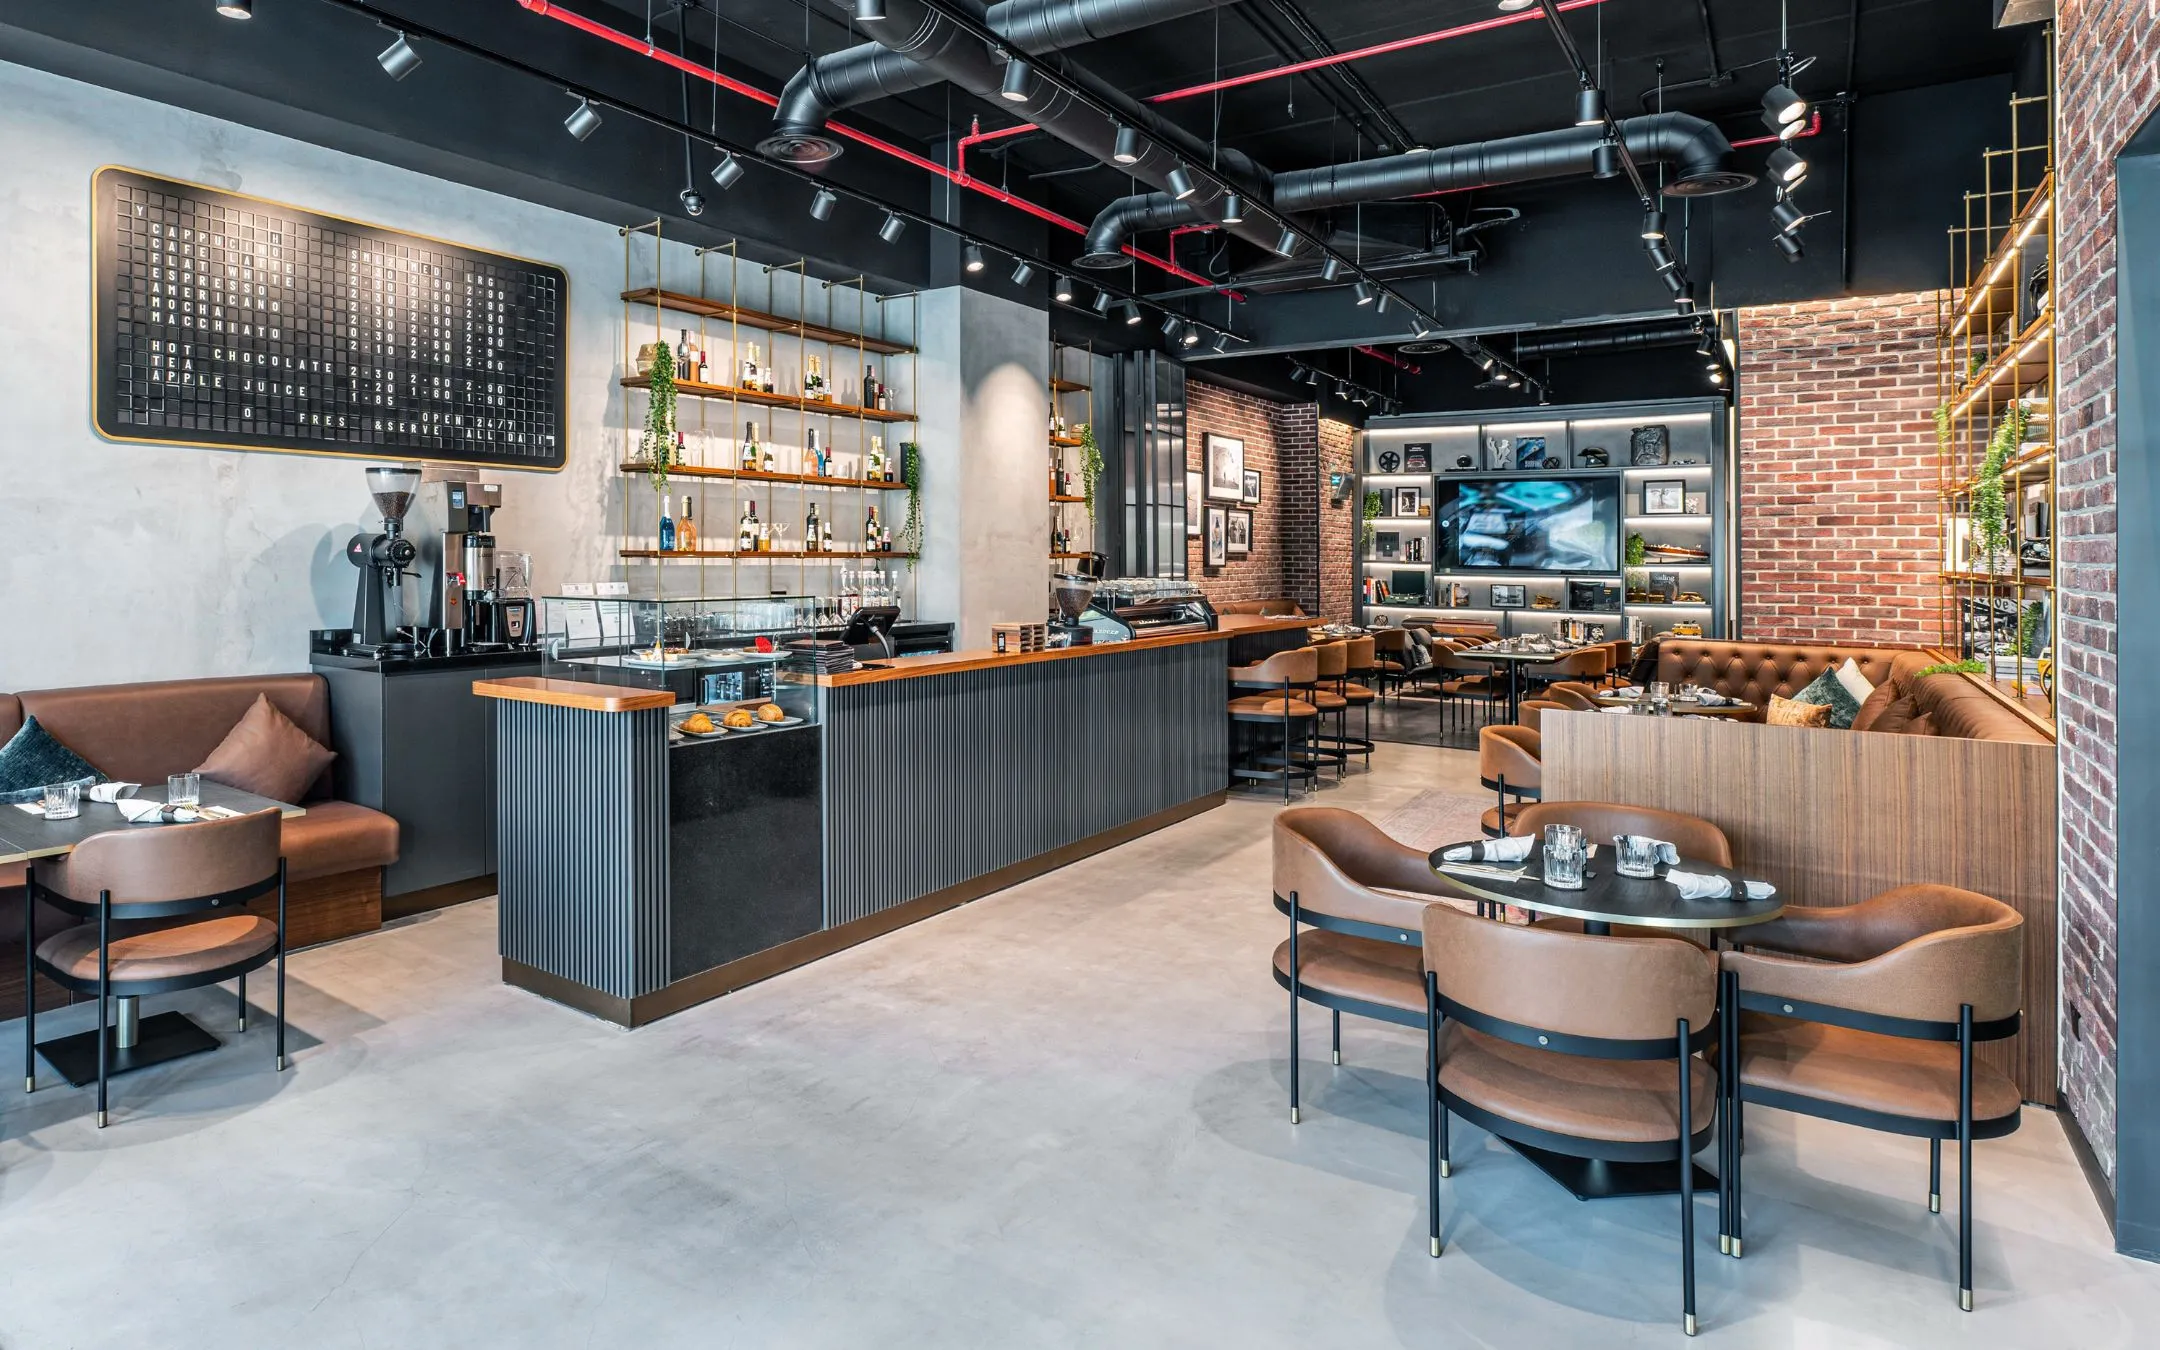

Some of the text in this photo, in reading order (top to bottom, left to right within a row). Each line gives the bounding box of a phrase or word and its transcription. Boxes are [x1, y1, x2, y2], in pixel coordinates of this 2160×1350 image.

[136, 205, 144, 217] Y
[272, 233, 279, 244] H
[411, 261, 439, 276] MED
[467, 273, 494, 287] LRG
[152, 223, 504, 300] CAPPUCINO 2.30 2.60 2.90
[152, 238, 504, 312] CAFE LATTE 2.30 2.60 2.90
[152, 253, 504, 323] FLAT WHITE 2.30 2.60 2.90
[152, 267, 504, 335] ESPRESSO 2.30 2.60 2.90
[152, 282, 504, 347] AMERICANO 2.30 2.60 2.90
[152, 296, 221, 317] MOCHA
[351, 328, 393, 342] 0.30
[411, 337, 450, 351] 2.60
[152, 311, 279, 339] MACCHIATO
[351, 340, 394, 355] 2.10
[411, 350, 450, 363] 2.40
[152, 340, 503, 394] HOT CHOCOLATE 2.30 2.60 2.90
[152, 355, 503, 406] TEA 1.20 1.60 1.90
[152, 370, 393, 406] APPLE JUICE 1.85
[300, 413, 345, 427] FRES
[466, 429, 493, 440] ALL
[508, 433, 523, 443] DA
[422, 412, 513, 430] OPEN 24/7
